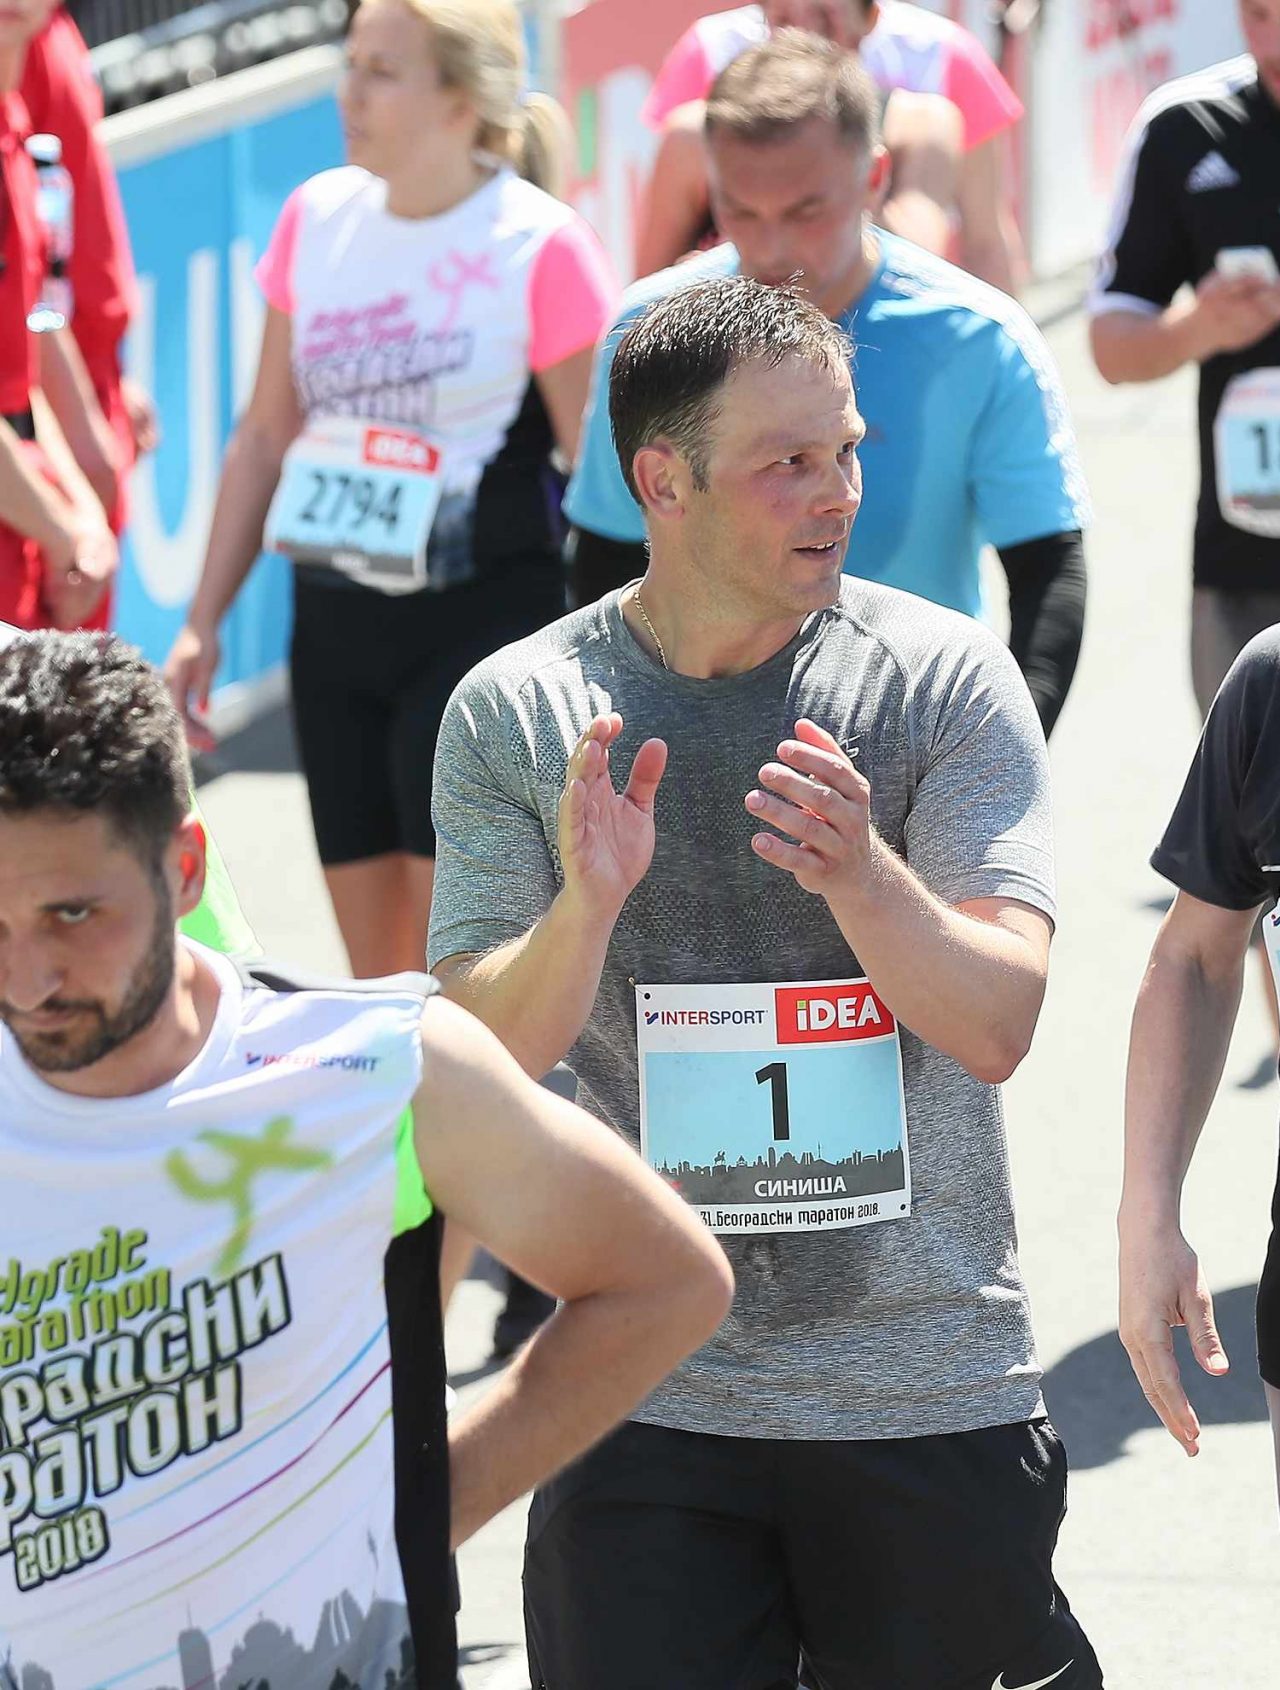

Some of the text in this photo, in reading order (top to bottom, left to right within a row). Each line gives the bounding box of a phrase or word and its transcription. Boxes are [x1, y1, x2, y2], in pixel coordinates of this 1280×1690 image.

[299, 470, 403, 533] 2794
[661, 1010, 766, 1026] INTERSPORT
[755, 1062, 790, 1141] 1
[754, 1176, 848, 1198] СИНИША
[0, 1266, 171, 1368] arathon
[14, 1503, 111, 1592] 2018
